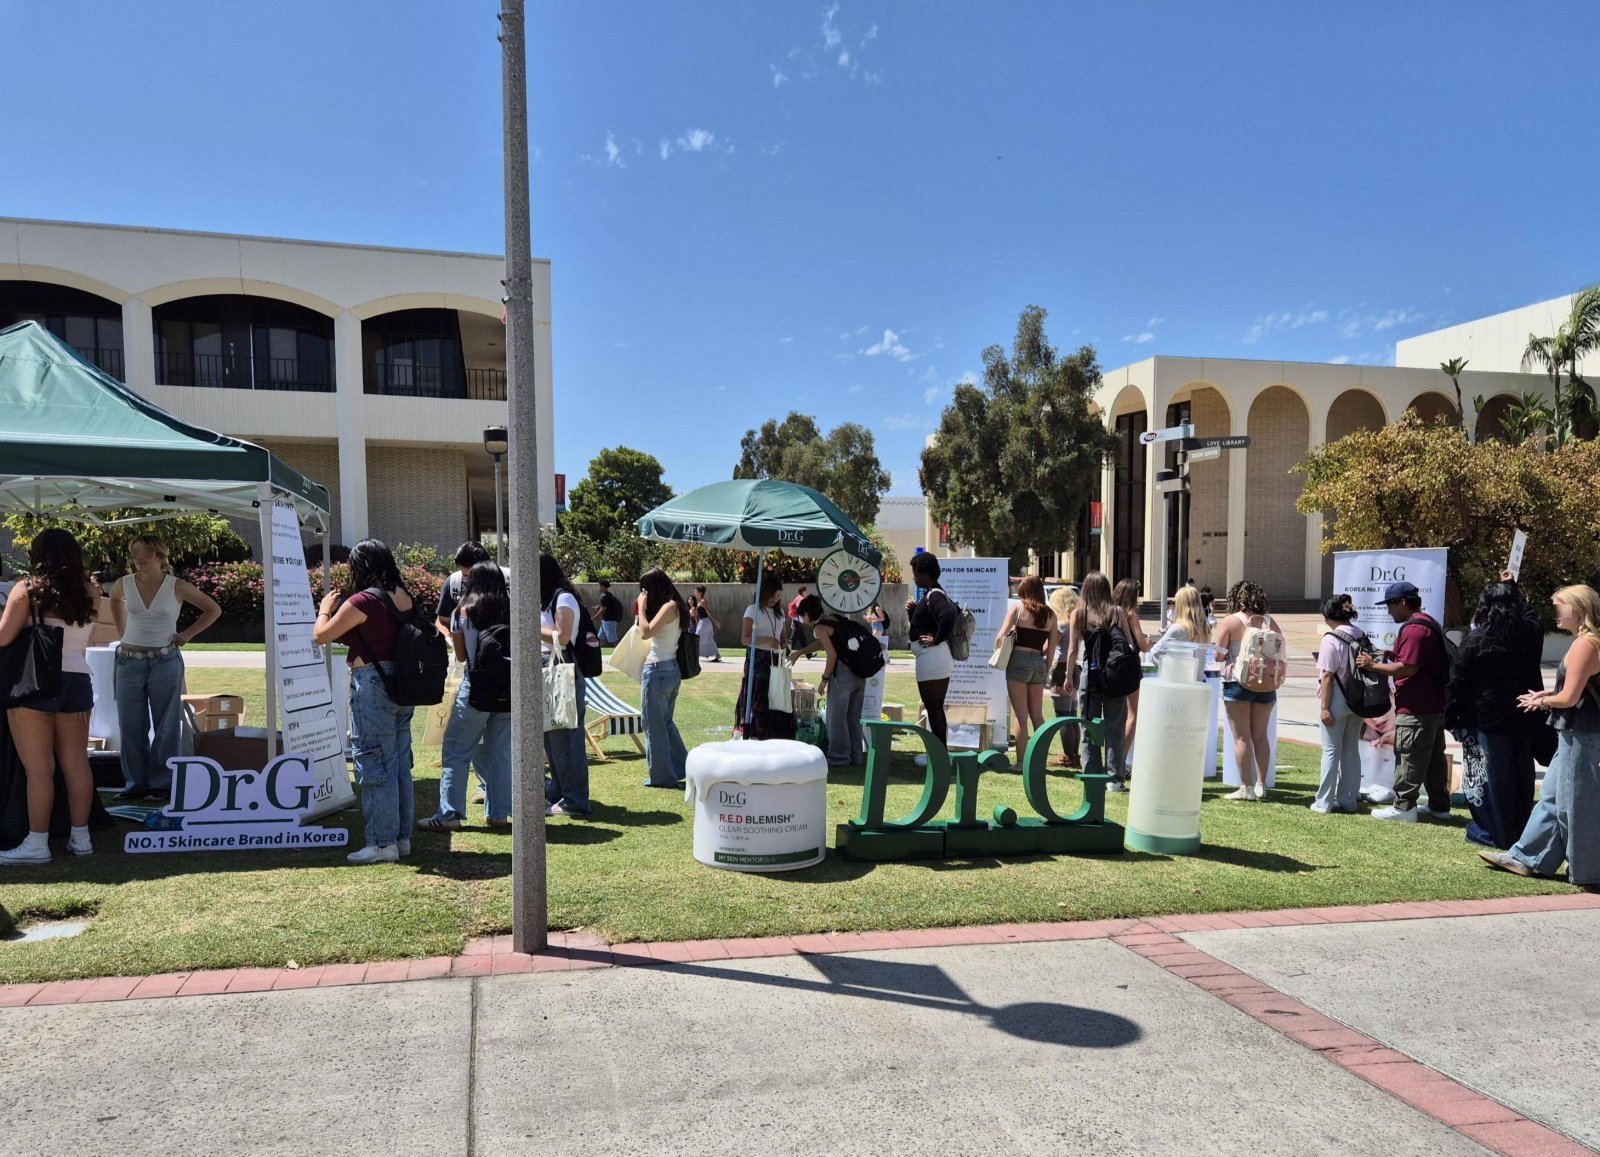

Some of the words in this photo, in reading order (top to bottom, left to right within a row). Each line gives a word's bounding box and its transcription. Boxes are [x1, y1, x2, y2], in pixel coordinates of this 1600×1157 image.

[683, 522, 706, 536] Dr.G
[777, 529, 804, 542] Dr.G
[1370, 566, 1406, 581] Dr.G
[848, 716, 1112, 829] Dr.G
[168, 757, 314, 813] Dr.G
[719, 790, 747, 806] Dr.G
[719, 813, 743, 824] R.E.D
[719, 825, 742, 834] CLEAR
[743, 825, 783, 835] SOOTHING
[784, 823, 808, 833] CREAM
[128, 837, 164, 849] NO.1
[168, 834, 236, 848] Skincare
[238, 831, 283, 847] Brand
[286, 831, 300, 844] in
[303, 830, 345, 844] Korea
